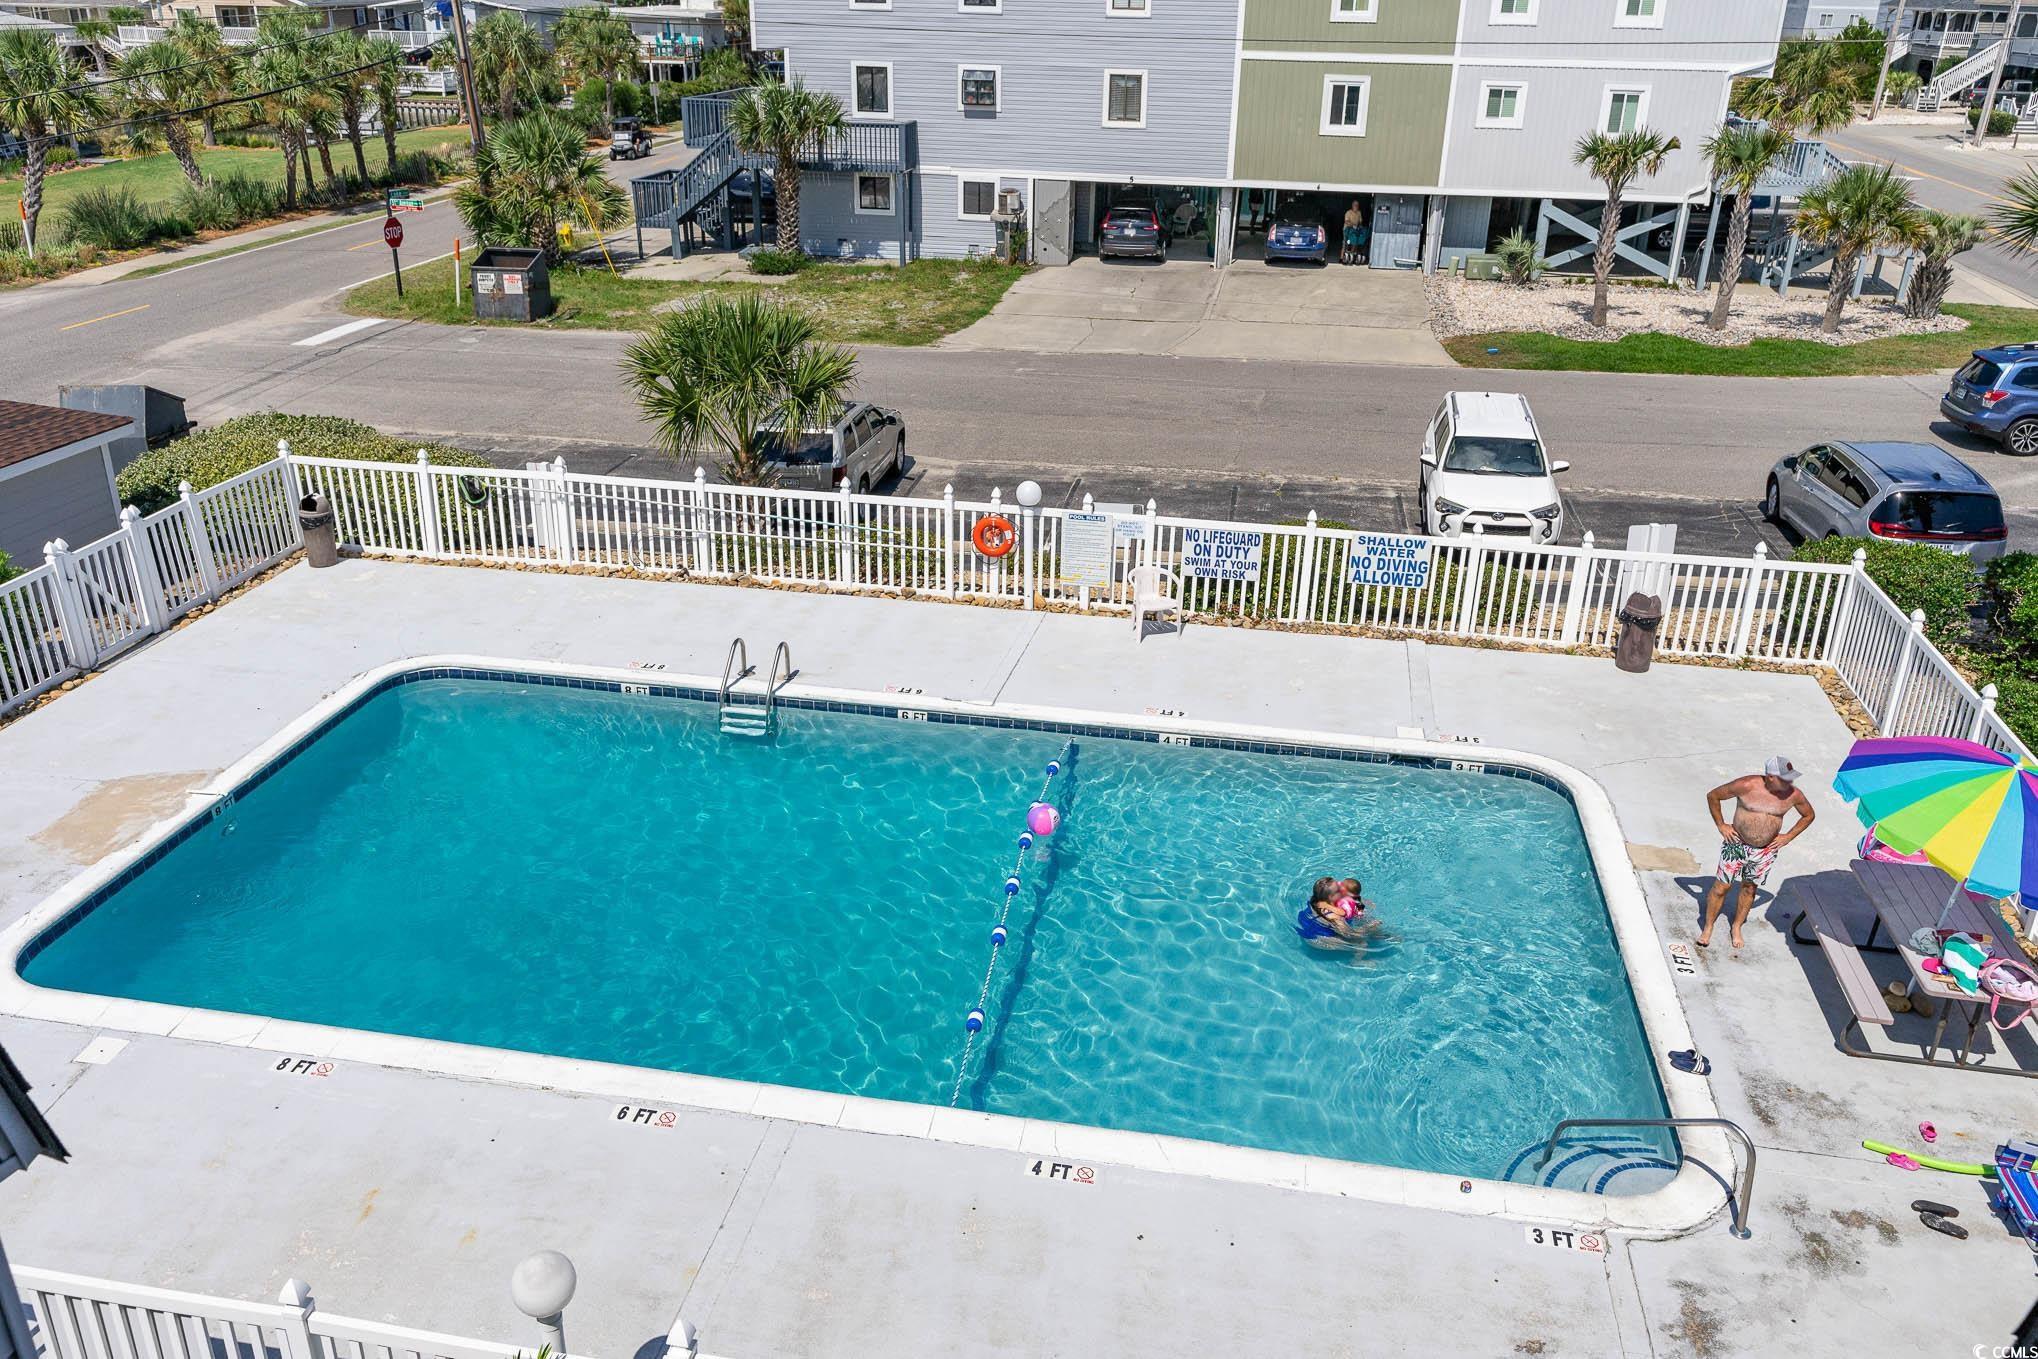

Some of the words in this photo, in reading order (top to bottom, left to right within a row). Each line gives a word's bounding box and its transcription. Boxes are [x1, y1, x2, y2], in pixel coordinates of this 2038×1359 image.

[385, 226, 402, 240] STOP
[1185, 528, 1200, 542] NO
[1203, 530, 1261, 547] LIFEGUARD
[1358, 535, 1426, 549] SHALLOW
[1193, 543, 1211, 557] ON
[1216, 544, 1250, 560] DUTY
[1366, 546, 1416, 559] WATER
[1184, 556, 1211, 567] SWIM
[1214, 559, 1227, 568] AT
[1230, 560, 1258, 571] YOUR
[1350, 555, 1372, 569] NO
[1376, 557, 1428, 574] DIVING
[1194, 567, 1218, 577] OWN
[1221, 569, 1246, 580] RISK
[1352, 569, 1424, 588] ALLOWED
[624, 686, 632, 694] 8
[636, 686, 648, 695] FT
[901, 711, 909, 720] 6
[913, 712, 926, 721] FT
[1163, 736, 1170, 744] 4
[1175, 737, 1189, 746] FT
[1455, 763, 1464, 771] 3
[1468, 764, 1483, 773] FT
[1671, 953, 1692, 965] FT
[276, 1057, 292, 1071] 8
[290, 1059, 318, 1075] FT
[616, 1105, 630, 1120] 6
[632, 1107, 658, 1125] FT
[1031, 1160, 1043, 1175] 4
[1049, 1162, 1073, 1180] FT
[1532, 1228, 1545, 1244] 3
[1551, 1230, 1574, 1249] FT
